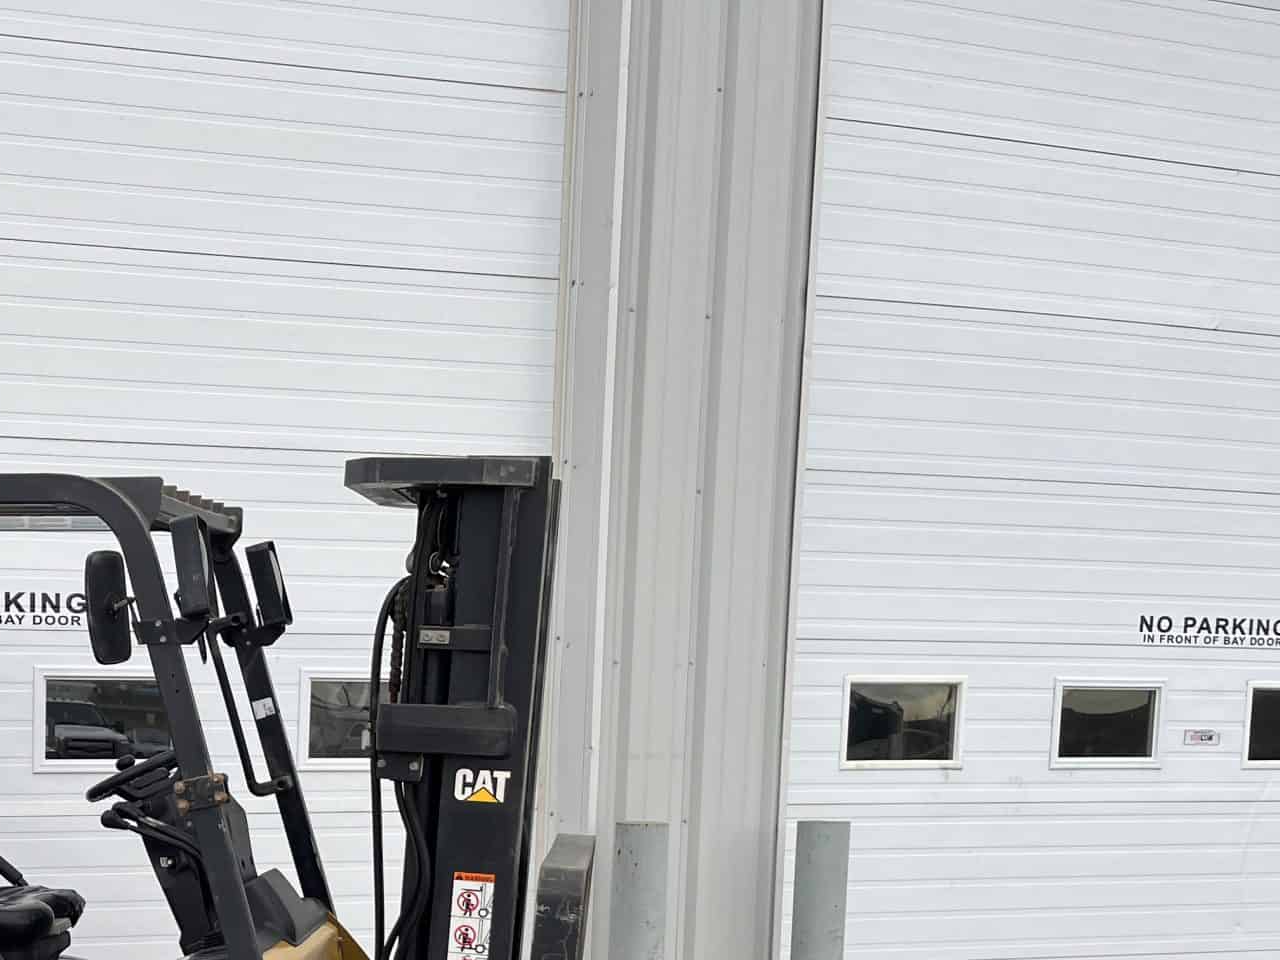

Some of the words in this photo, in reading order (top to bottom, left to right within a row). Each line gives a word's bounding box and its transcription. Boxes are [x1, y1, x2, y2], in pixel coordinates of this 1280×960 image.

[32, 614, 82, 626] DOOR
[1139, 615, 1173, 633] NO
[1143, 634, 1154, 643] IN
[1159, 634, 1199, 644] FRONT
[1203, 635, 1219, 645] OF
[1223, 636, 1246, 646] BAY
[454, 768, 511, 803] CAT
